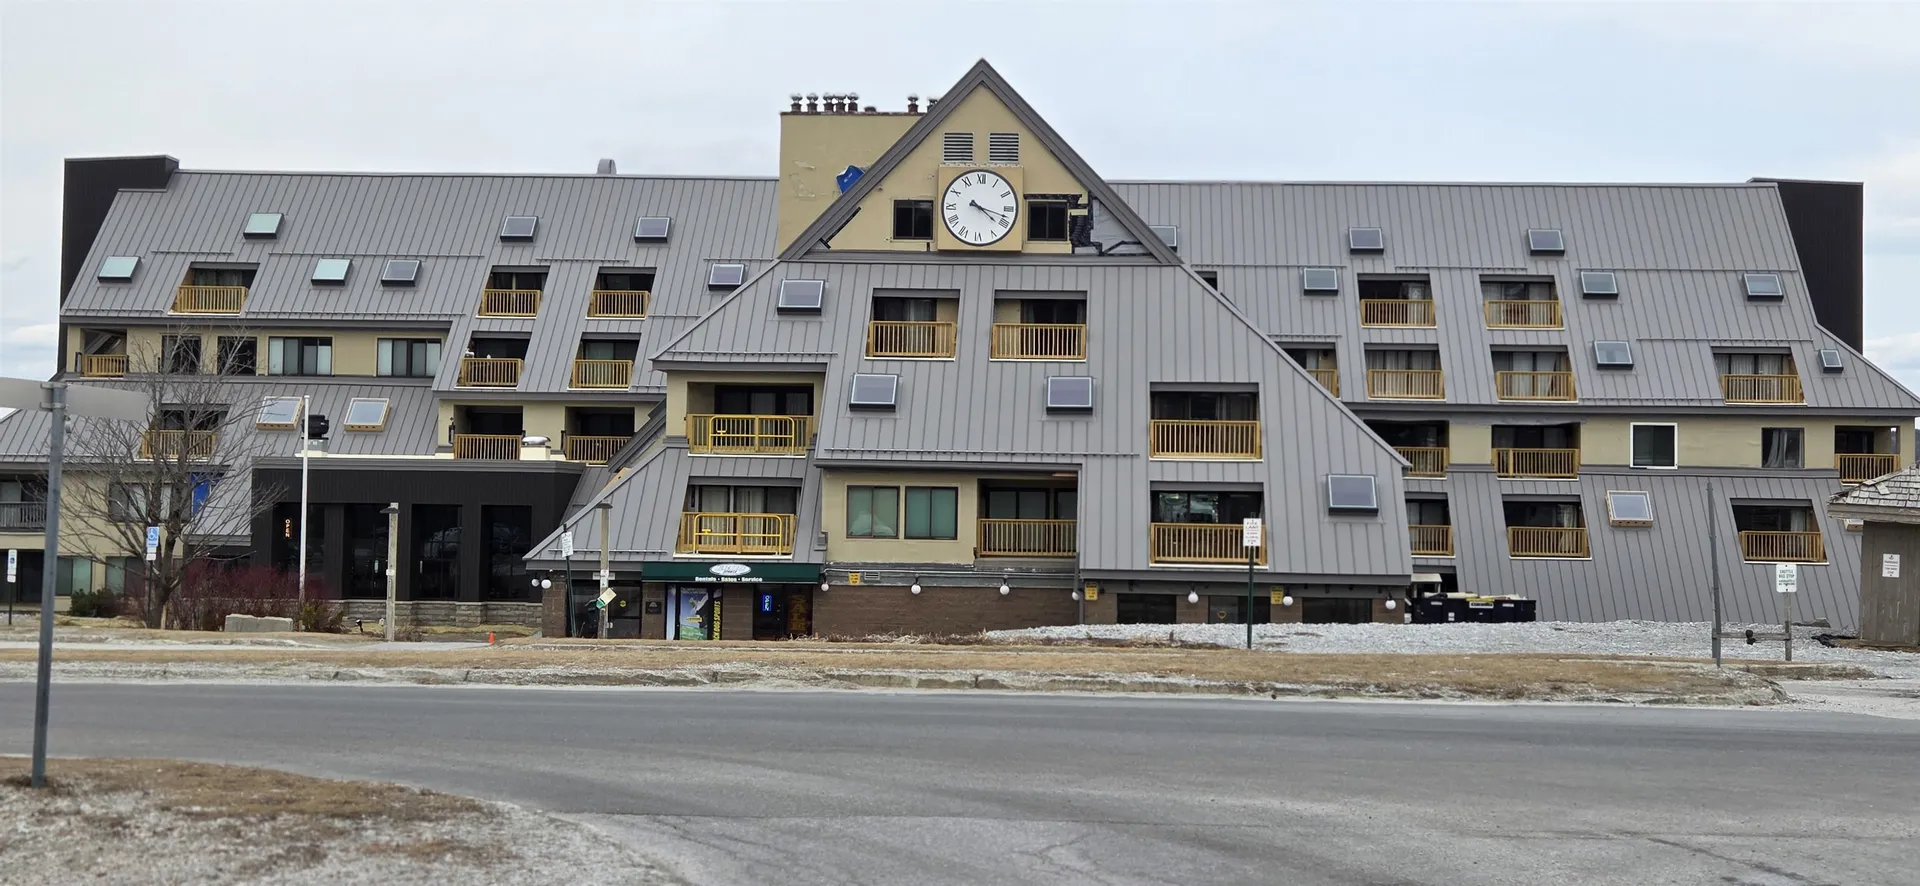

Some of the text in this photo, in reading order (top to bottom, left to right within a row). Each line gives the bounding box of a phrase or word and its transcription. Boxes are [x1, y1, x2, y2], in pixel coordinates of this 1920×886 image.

[961, 176, 972, 188] XI
[976, 174, 986, 184] XII
[950, 188, 961, 197] X
[948, 214, 959, 228] VIII
[958, 226, 968, 238] VII
[974, 232, 982, 241] VI
[990, 230, 997, 239] V
